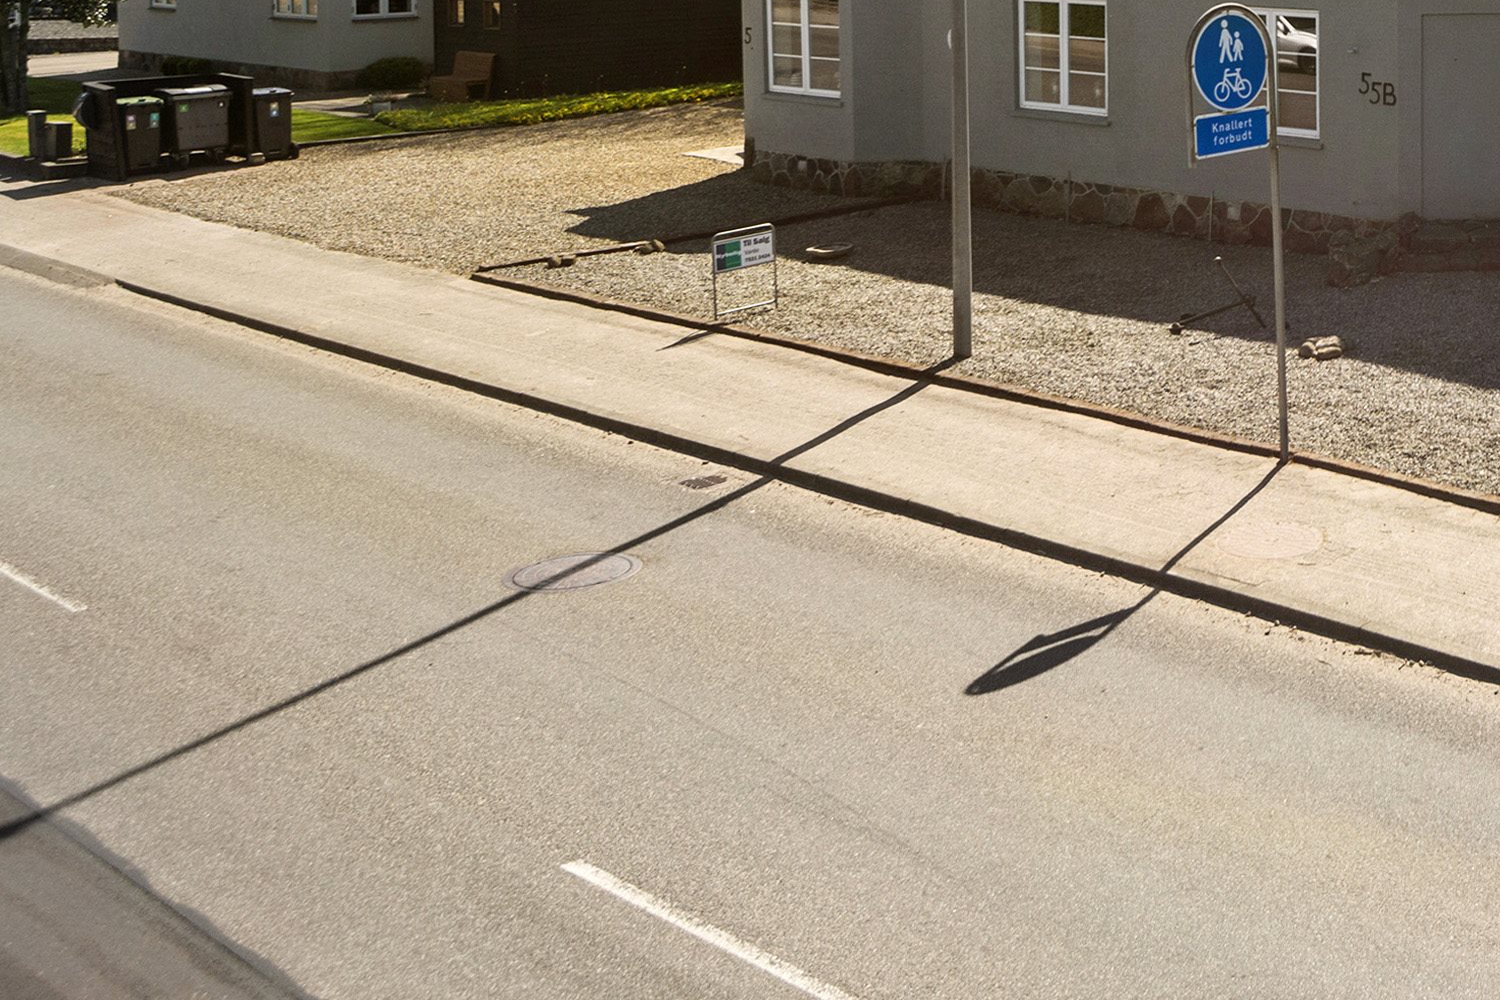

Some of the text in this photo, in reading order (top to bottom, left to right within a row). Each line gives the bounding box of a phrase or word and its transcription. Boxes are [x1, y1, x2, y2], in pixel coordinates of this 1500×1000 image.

[744, 27, 752, 44] 5
[1358, 72, 1397, 106] 55B
[1212, 118, 1252, 133] Knallert
[1213, 130, 1252, 146] forbudt
[753, 236, 770, 245] Salg
